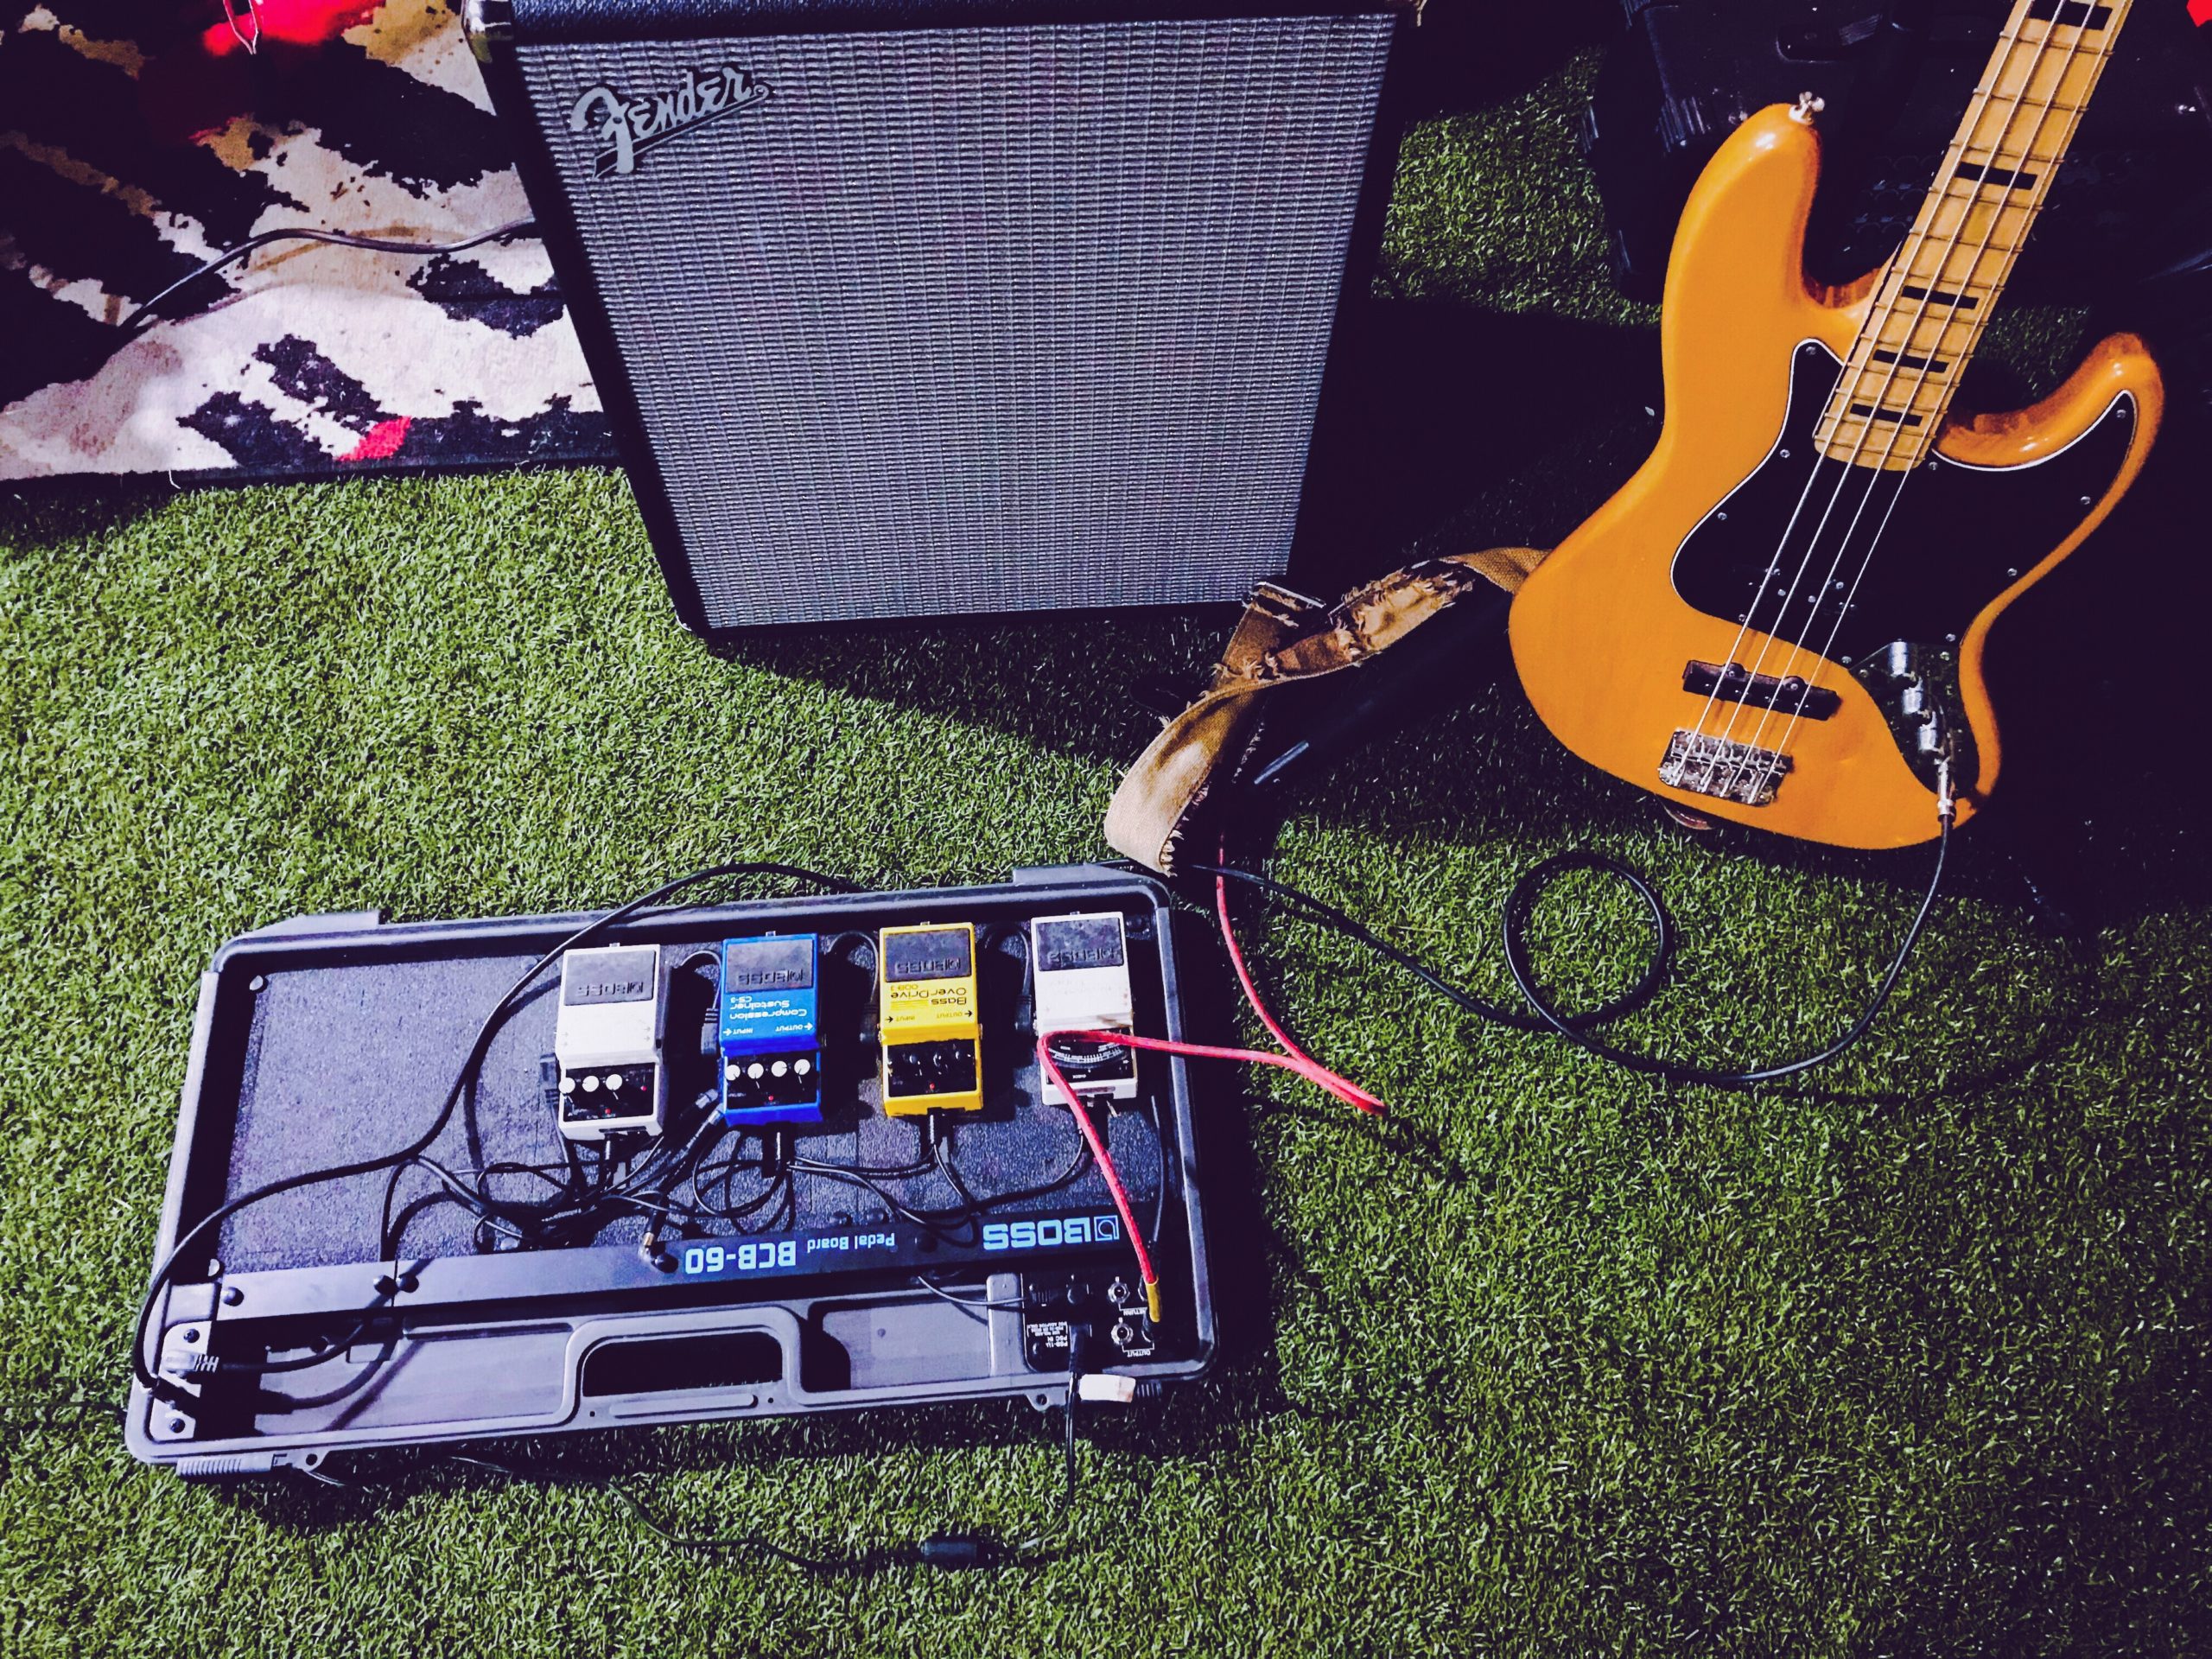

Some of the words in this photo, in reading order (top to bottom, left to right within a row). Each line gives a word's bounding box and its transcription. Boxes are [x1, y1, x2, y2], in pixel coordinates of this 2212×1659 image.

[569, 67, 760, 175] Fender
[730, 1000, 790, 1009] Sustainer
[931, 996, 967, 1006] Bass
[729, 1008, 807, 1020] Compression
[855, 1233, 895, 1249] Pedal
[983, 1217, 1091, 1250] BOSS
[807, 1236, 849, 1253] Board
[685, 1241, 796, 1274] BCB-60
